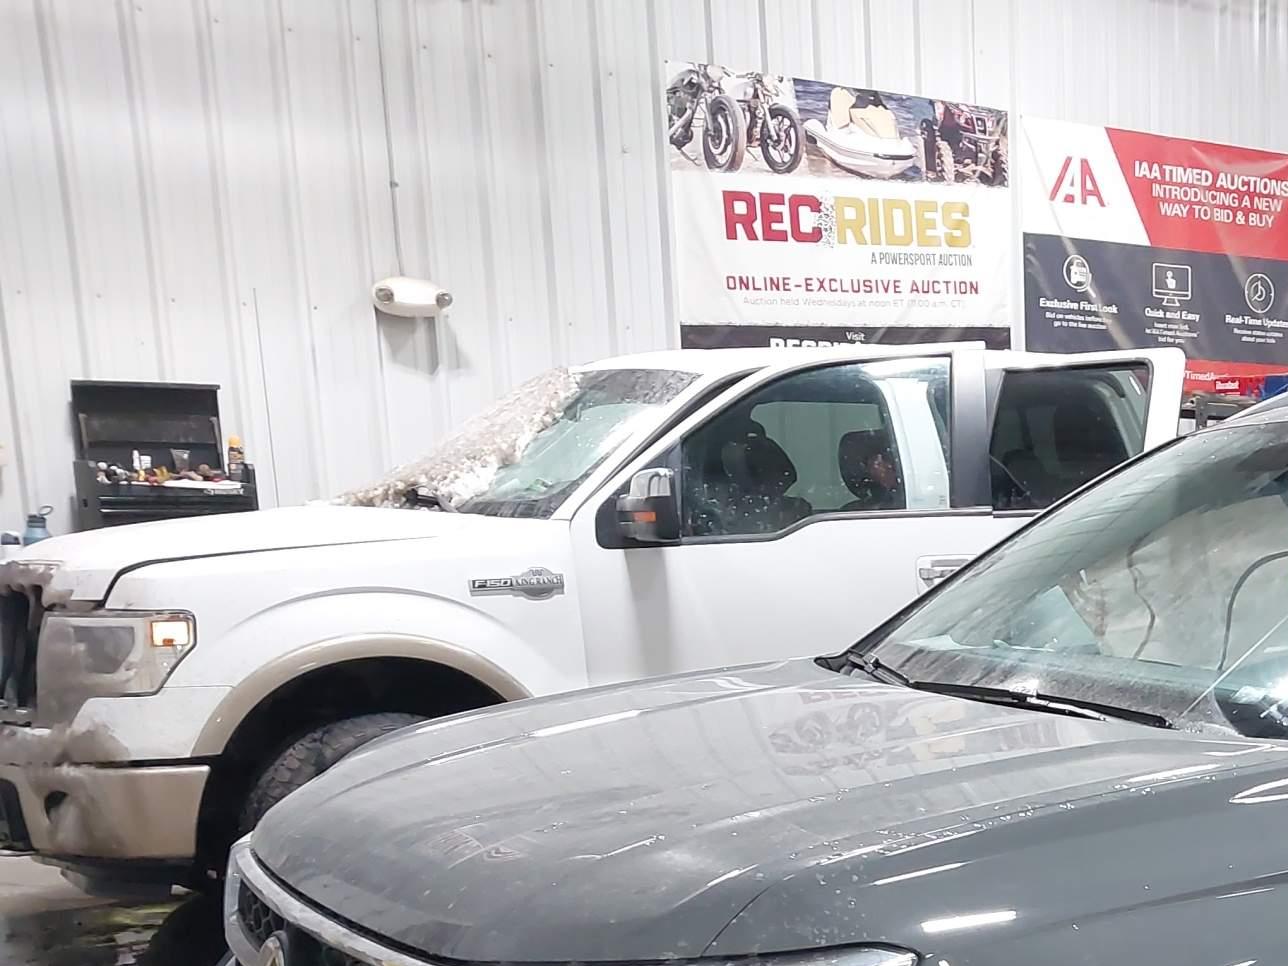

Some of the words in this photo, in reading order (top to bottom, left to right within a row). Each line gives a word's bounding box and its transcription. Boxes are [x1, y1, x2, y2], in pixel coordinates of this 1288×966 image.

[1134, 160, 1161, 180] IAA
[1162, 165, 1212, 187] TIMED
[1152, 183, 1239, 207] INTRODUCING
[1241, 195, 1251, 209] A
[1253, 198, 1283, 212] NEW
[834, 196, 973, 249] RIDES
[1159, 202, 1190, 218] WAY
[1192, 204, 1210, 220] TO
[1213, 208, 1233, 223] BID
[1235, 211, 1246, 225] &
[1248, 212, 1274, 228] BUY
[871, 252, 877, 264] A
[879, 252, 937, 266] POWERSPORT
[938, 253, 973, 267] AUCTION
[726, 275, 903, 294] ONLINE-EXCLUSIVE
[910, 279, 979, 295] AUCTION
[743, 297, 778, 306] Auction
[780, 297, 800, 306] held
[1039, 298, 1079, 310] Exclusive
[1080, 301, 1099, 312] First
[1099, 304, 1119, 314] Look
[1144, 307, 1165, 318] Quick
[1165, 310, 1181, 319] and
[1181, 310, 1201, 322] Easy
[1225, 314, 1262, 326] Real-Time
[845, 331, 866, 341] Visit
[535, 575, 563, 585] RANCH
